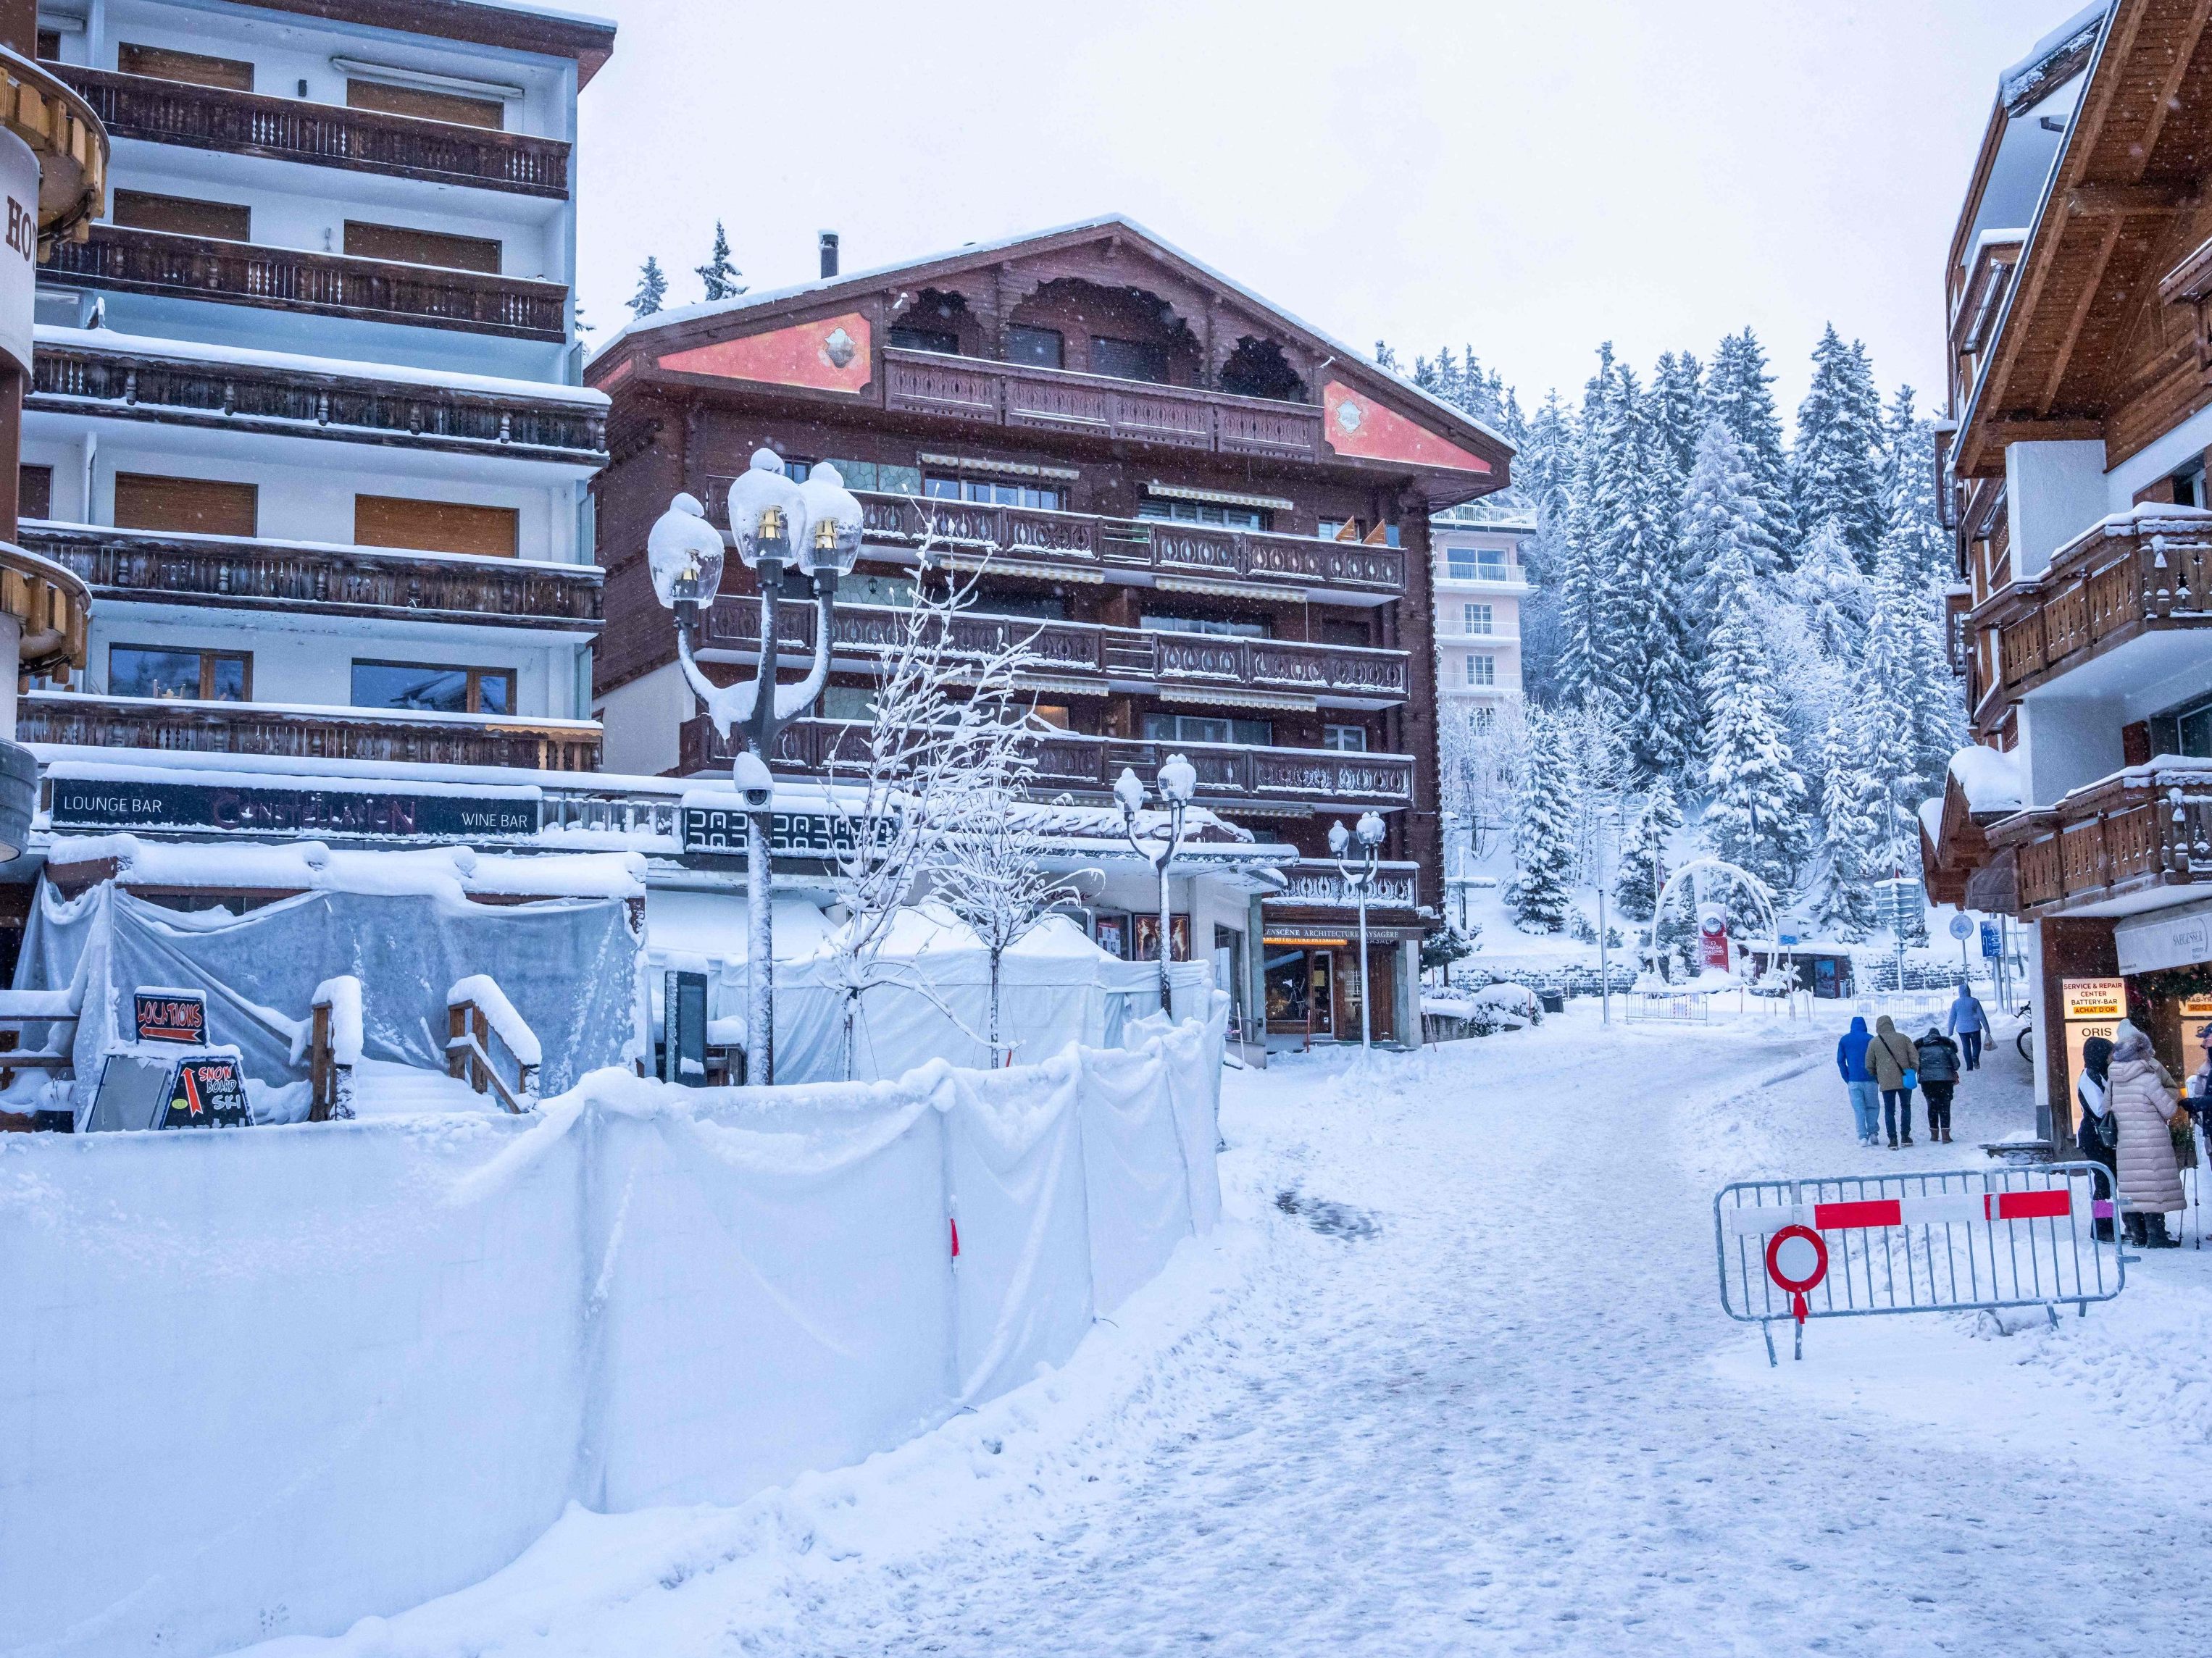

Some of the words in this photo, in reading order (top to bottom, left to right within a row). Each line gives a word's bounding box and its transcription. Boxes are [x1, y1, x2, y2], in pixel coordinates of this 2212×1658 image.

[64, 796, 128, 811] LOUNGE
[132, 799, 162, 813] BAR
[462, 813, 497, 826] WINE
[501, 815, 527, 828] BAR
[138, 1000, 202, 1027] LOCATIONS
[2082, 1028, 2112, 1037] ORIS
[199, 1066, 232, 1081] SNOW
[206, 1079, 237, 1093] BOARD
[212, 1094, 241, 1110] SKI
